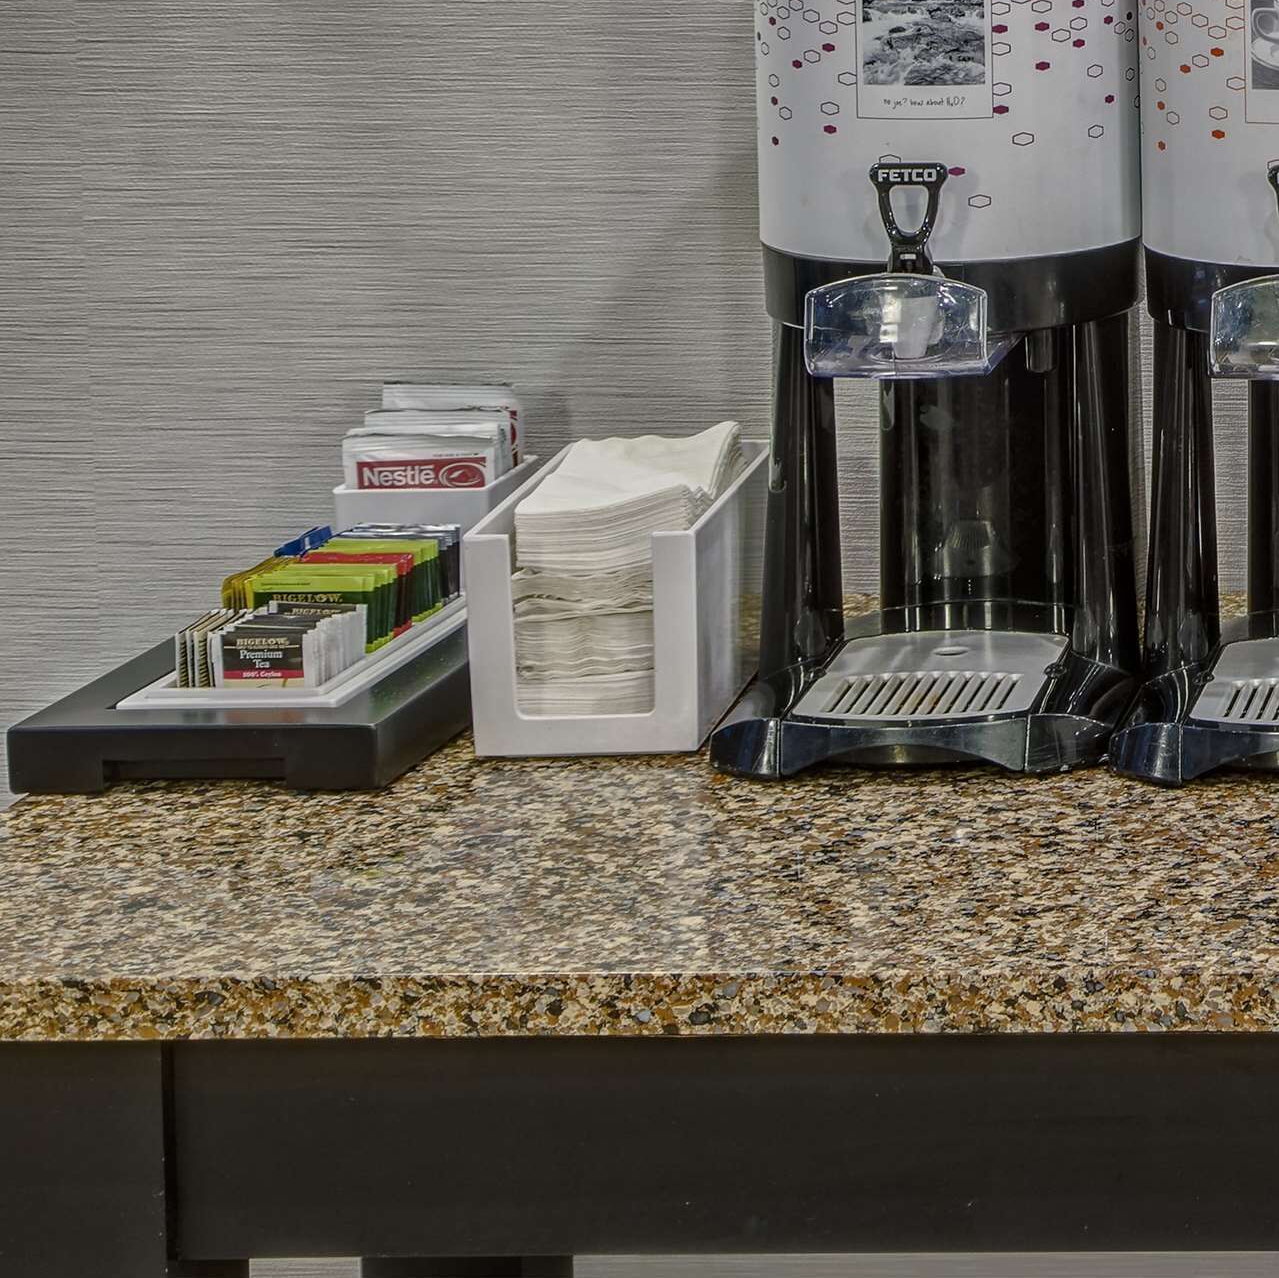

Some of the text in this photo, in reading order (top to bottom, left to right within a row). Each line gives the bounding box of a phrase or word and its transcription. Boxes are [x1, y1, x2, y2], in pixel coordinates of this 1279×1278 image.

[877, 168, 937, 182] FETCO
[236, 637, 289, 646] BIGELOW
[240, 650, 283, 659] Premium
[253, 659, 270, 668] Tea
